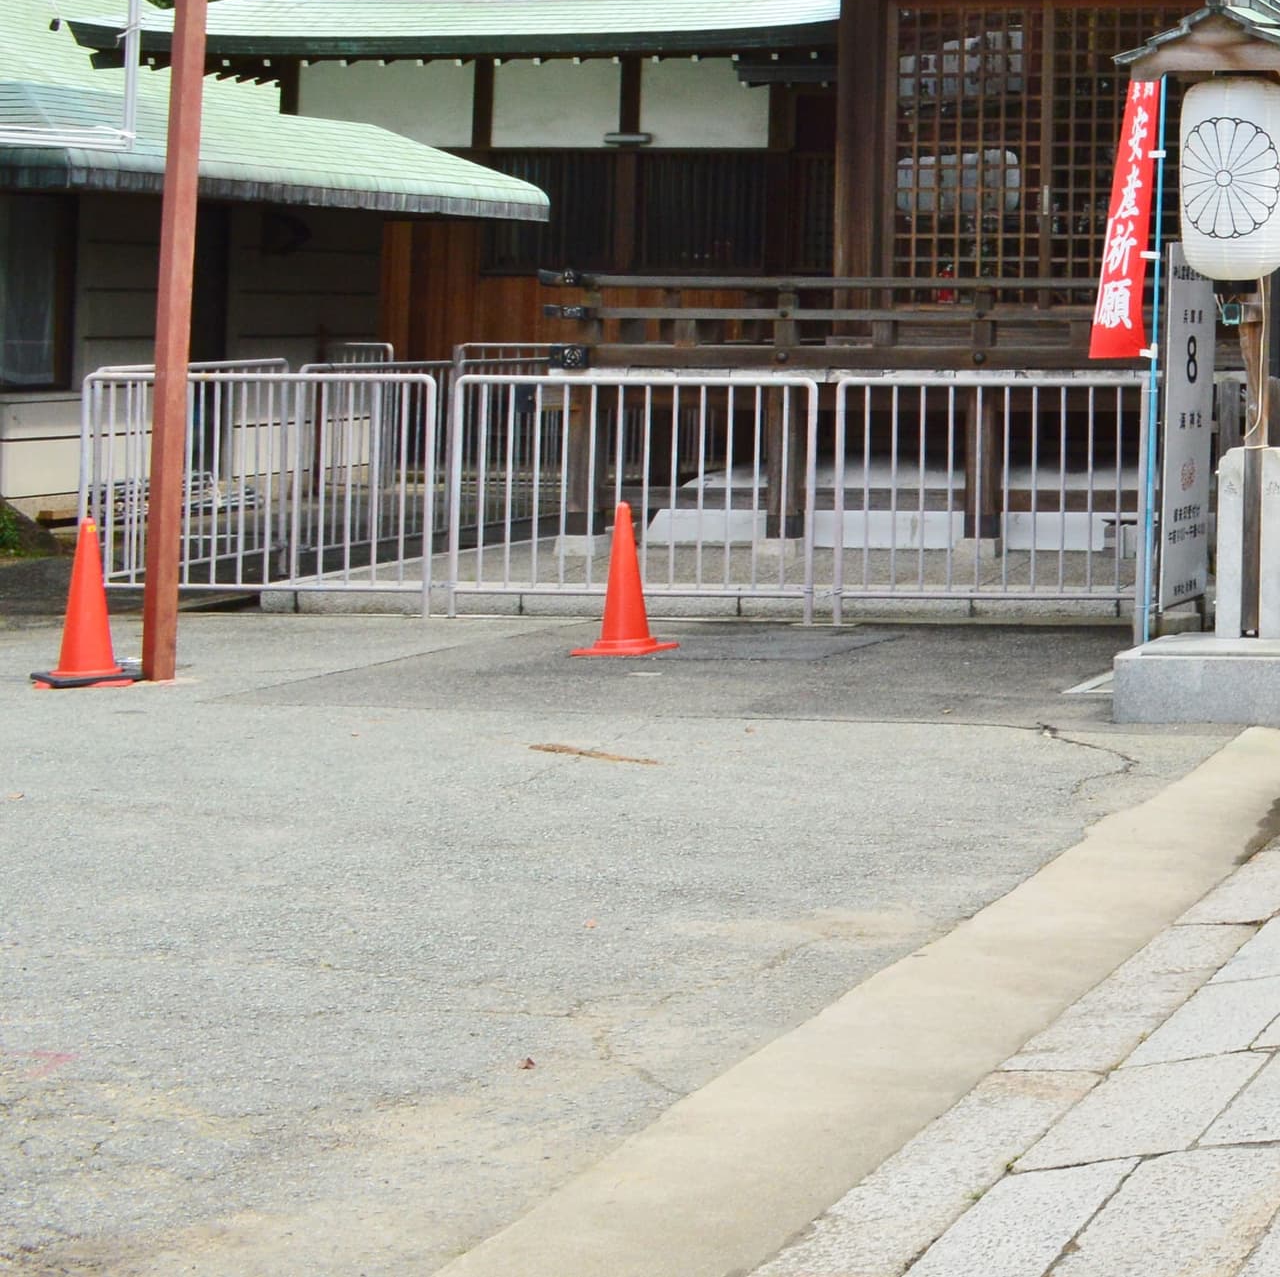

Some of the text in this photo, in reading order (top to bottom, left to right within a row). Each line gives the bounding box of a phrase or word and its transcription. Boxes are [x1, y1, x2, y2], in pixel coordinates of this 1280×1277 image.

[1098, 106, 1149, 329] 安産祈願
[1186, 335, 1198, 384] 8
